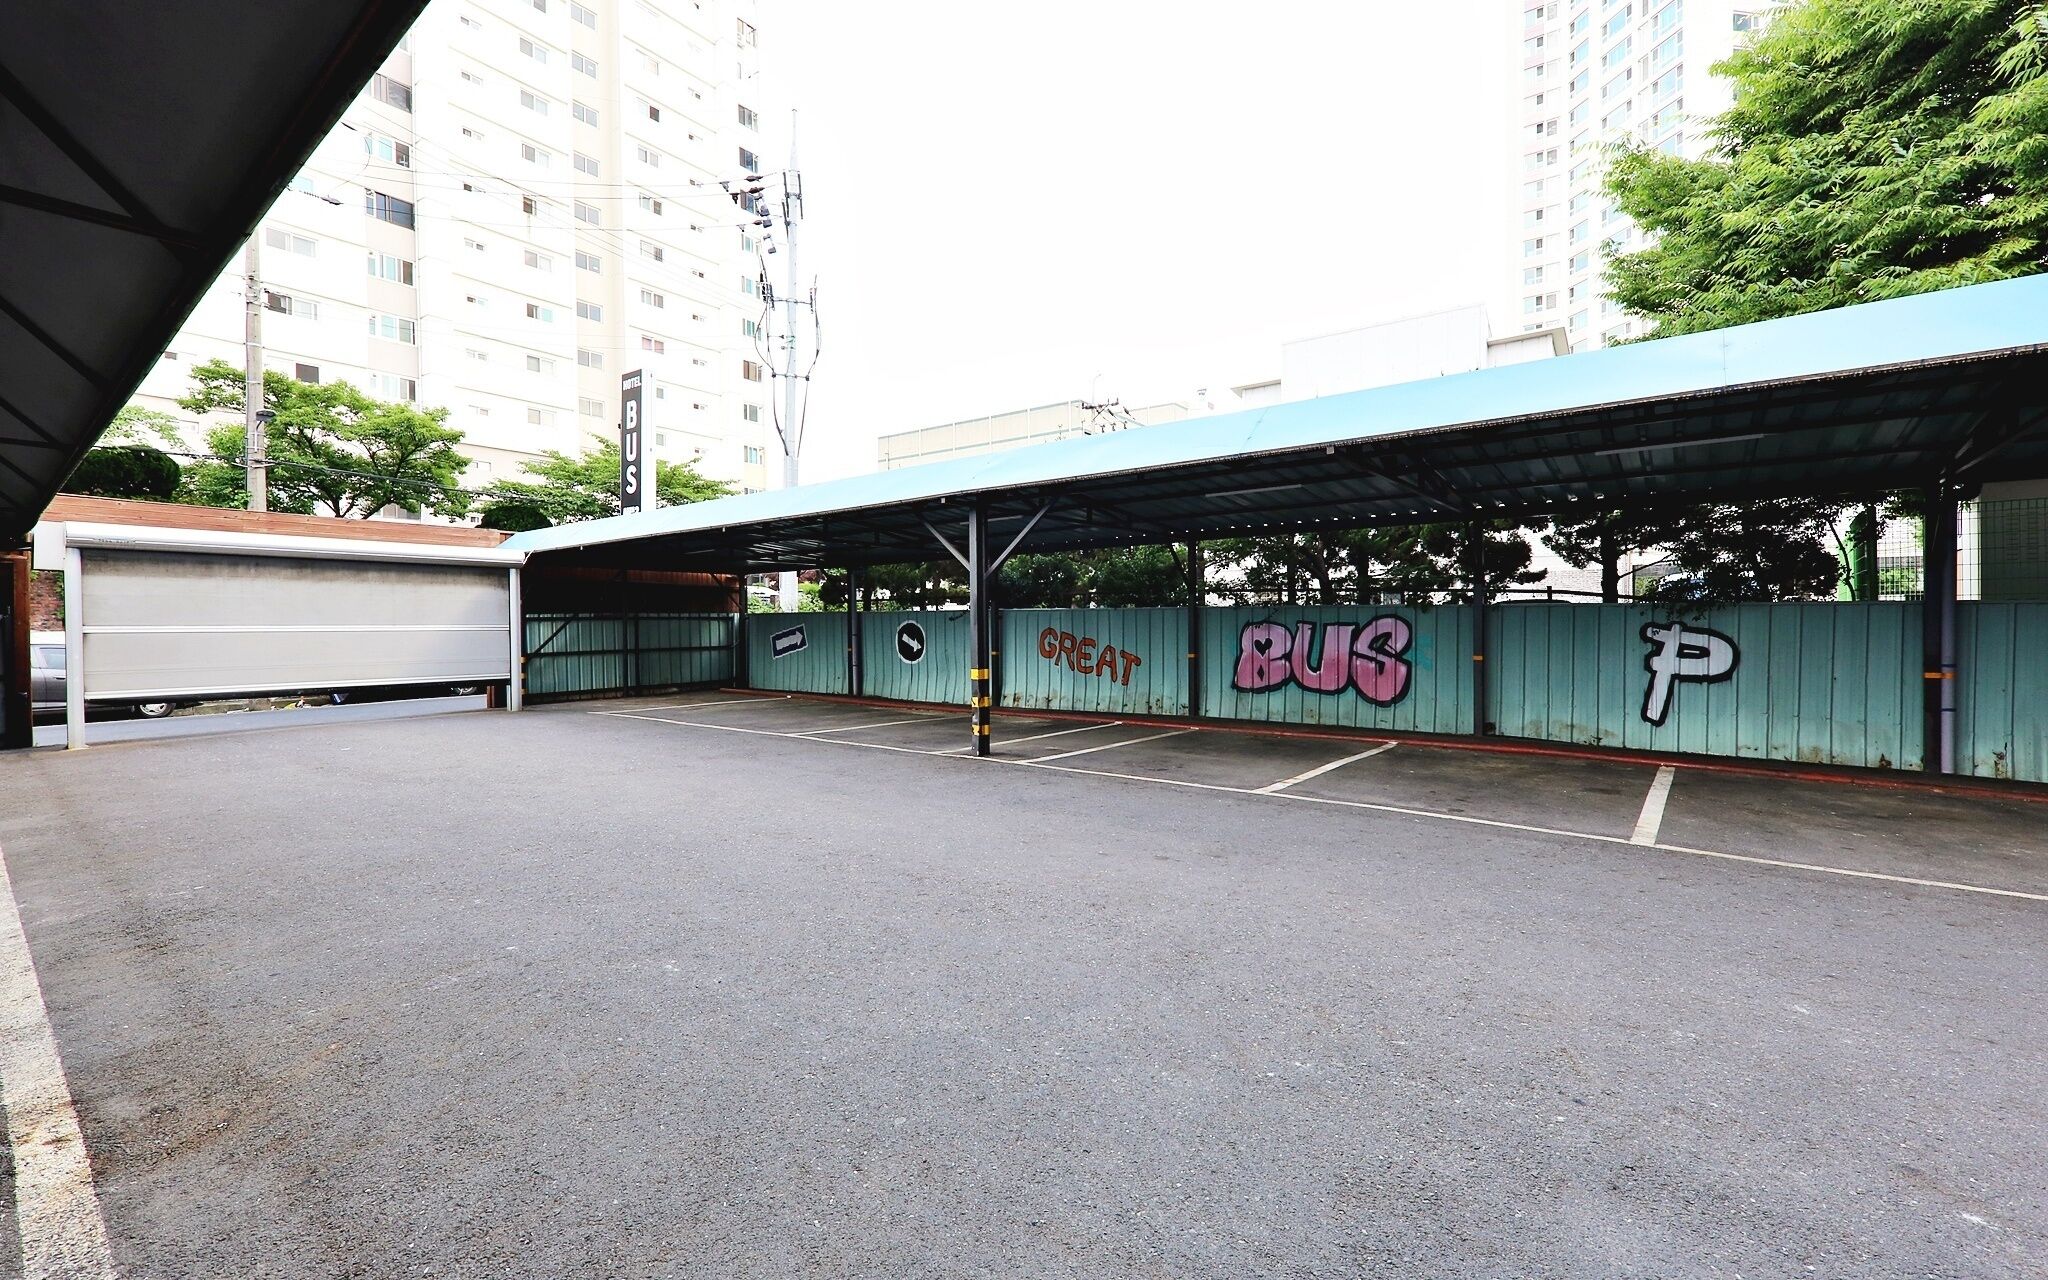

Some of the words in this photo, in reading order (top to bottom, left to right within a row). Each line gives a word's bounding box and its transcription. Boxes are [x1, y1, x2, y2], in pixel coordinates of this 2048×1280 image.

[625, 400, 637, 494] BUS
[1038, 627, 1141, 686] GREAT
[1232, 614, 1412, 708] BUS
[1640, 622, 1740, 727] P
